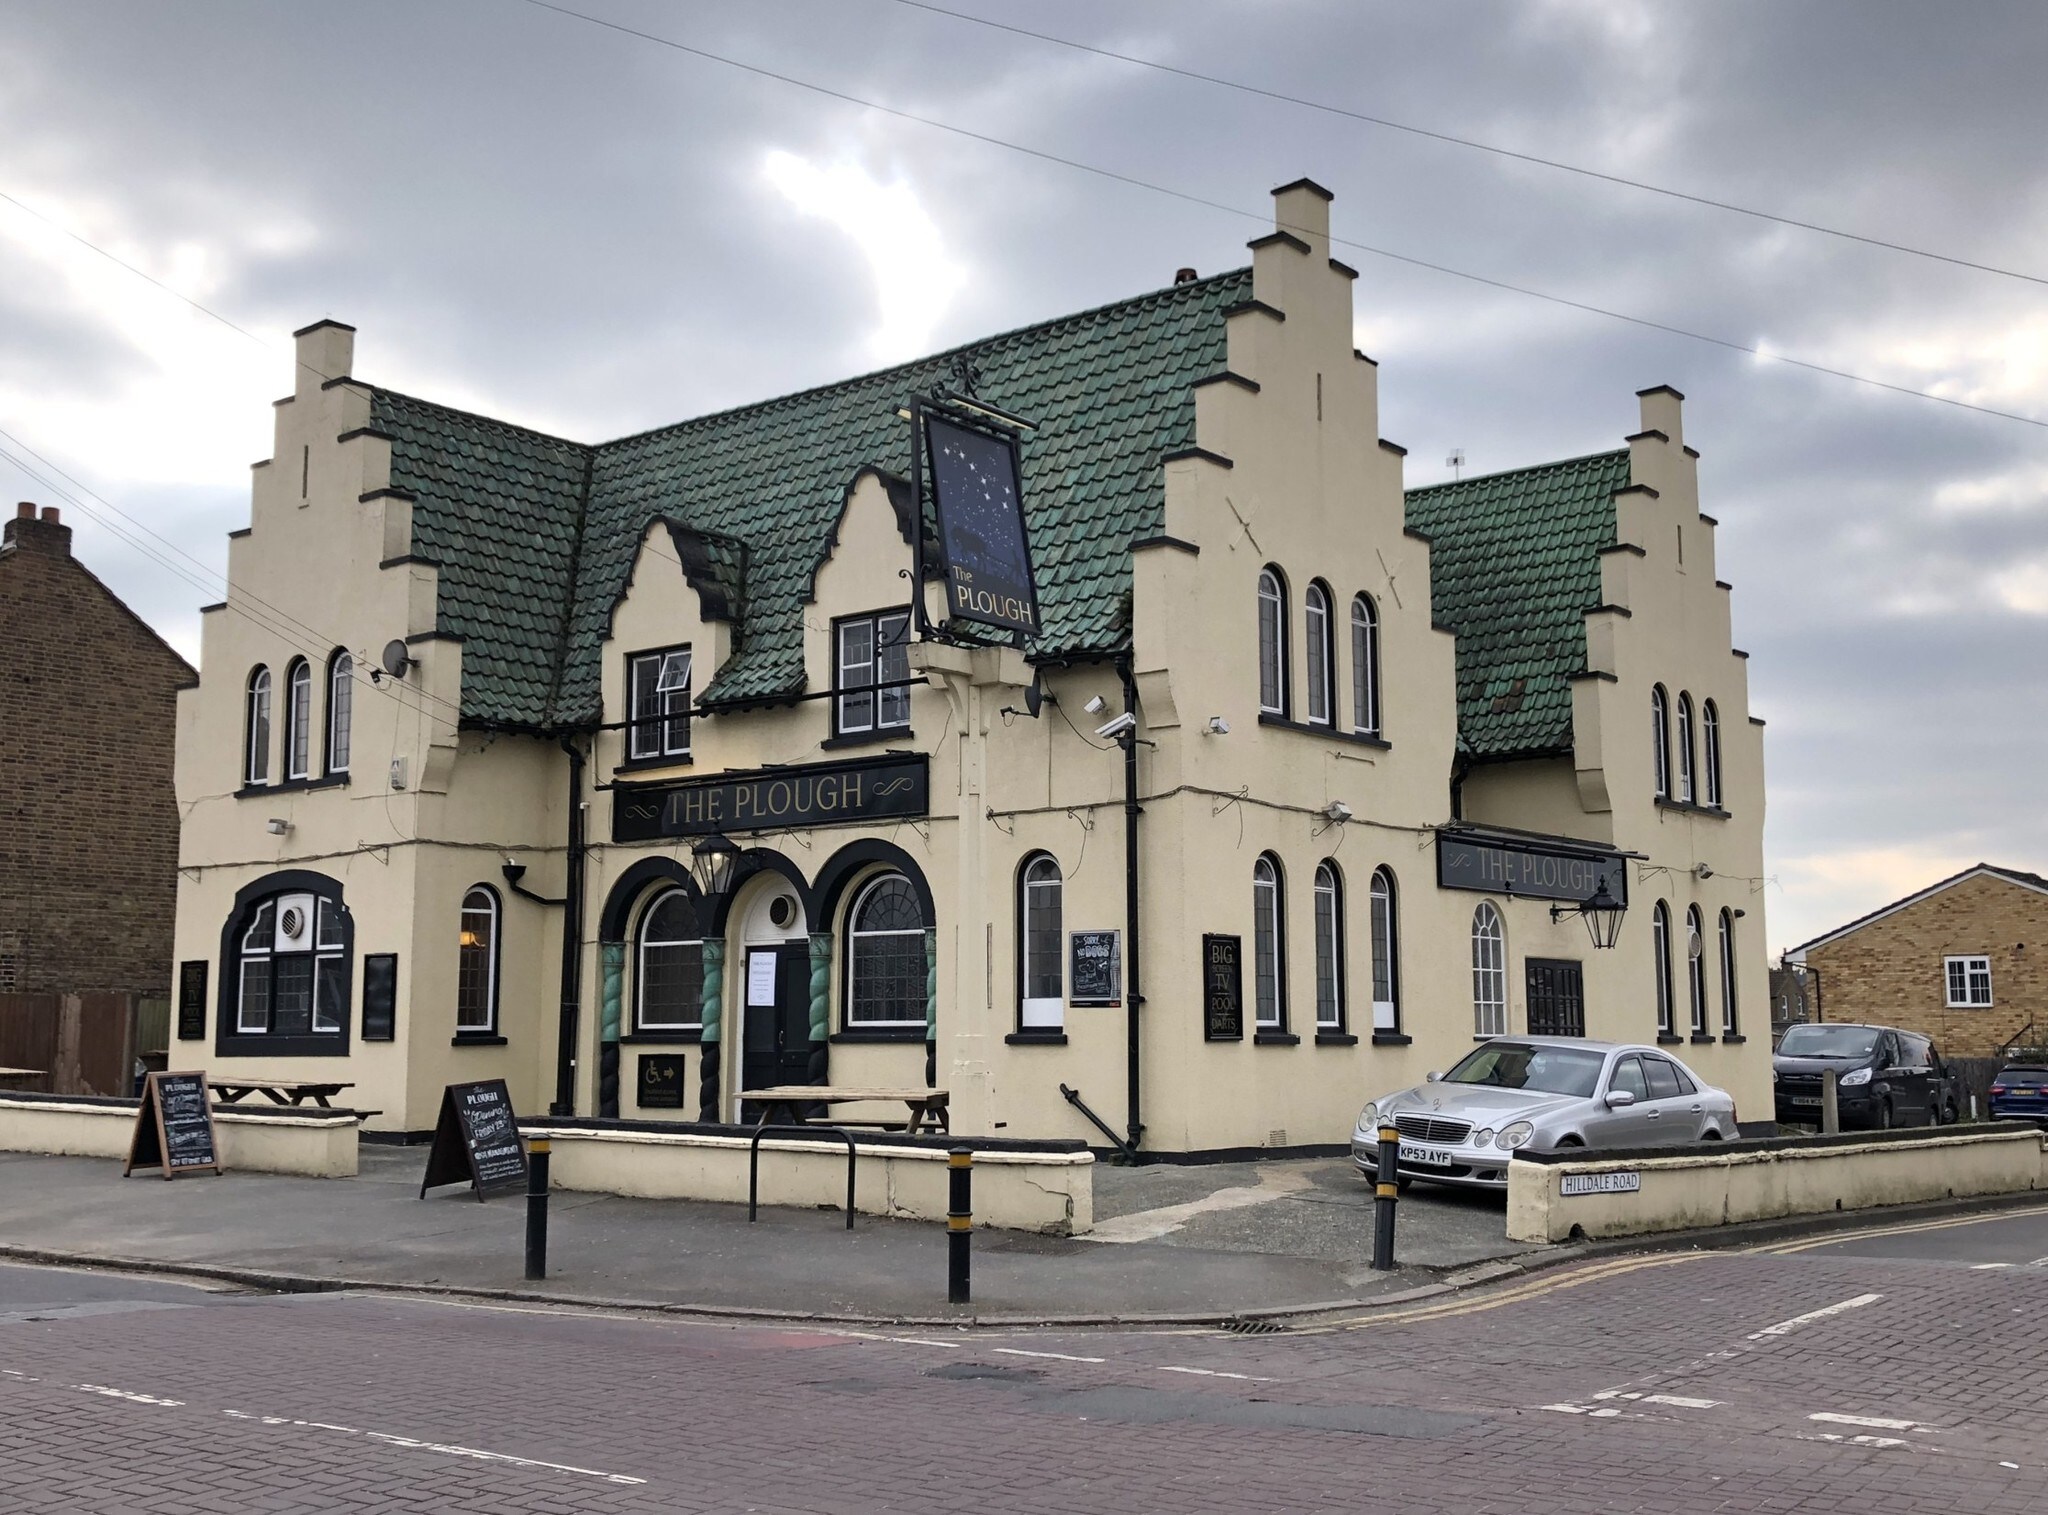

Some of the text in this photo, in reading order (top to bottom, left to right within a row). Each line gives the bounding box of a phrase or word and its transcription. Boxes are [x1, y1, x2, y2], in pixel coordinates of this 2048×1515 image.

[953, 565, 973, 583] The
[957, 584, 1033, 625] PLOUGH
[669, 773, 863, 825] THE PLOUGH
[1477, 847, 1595, 892] THE PLOUGH
[1085, 945, 1110, 957] DOGS
[1212, 945, 1233, 964] BIG
[1215, 973, 1230, 990] TV
[1212, 997, 1236, 1010] POOL
[1211, 1018, 1236, 1030] DARTS
[466, 1092, 498, 1105] PLOUGH
[1400, 1147, 1450, 1163] KP53 AYF
[1565, 1174, 1637, 1193] HILLDALE ROAD
